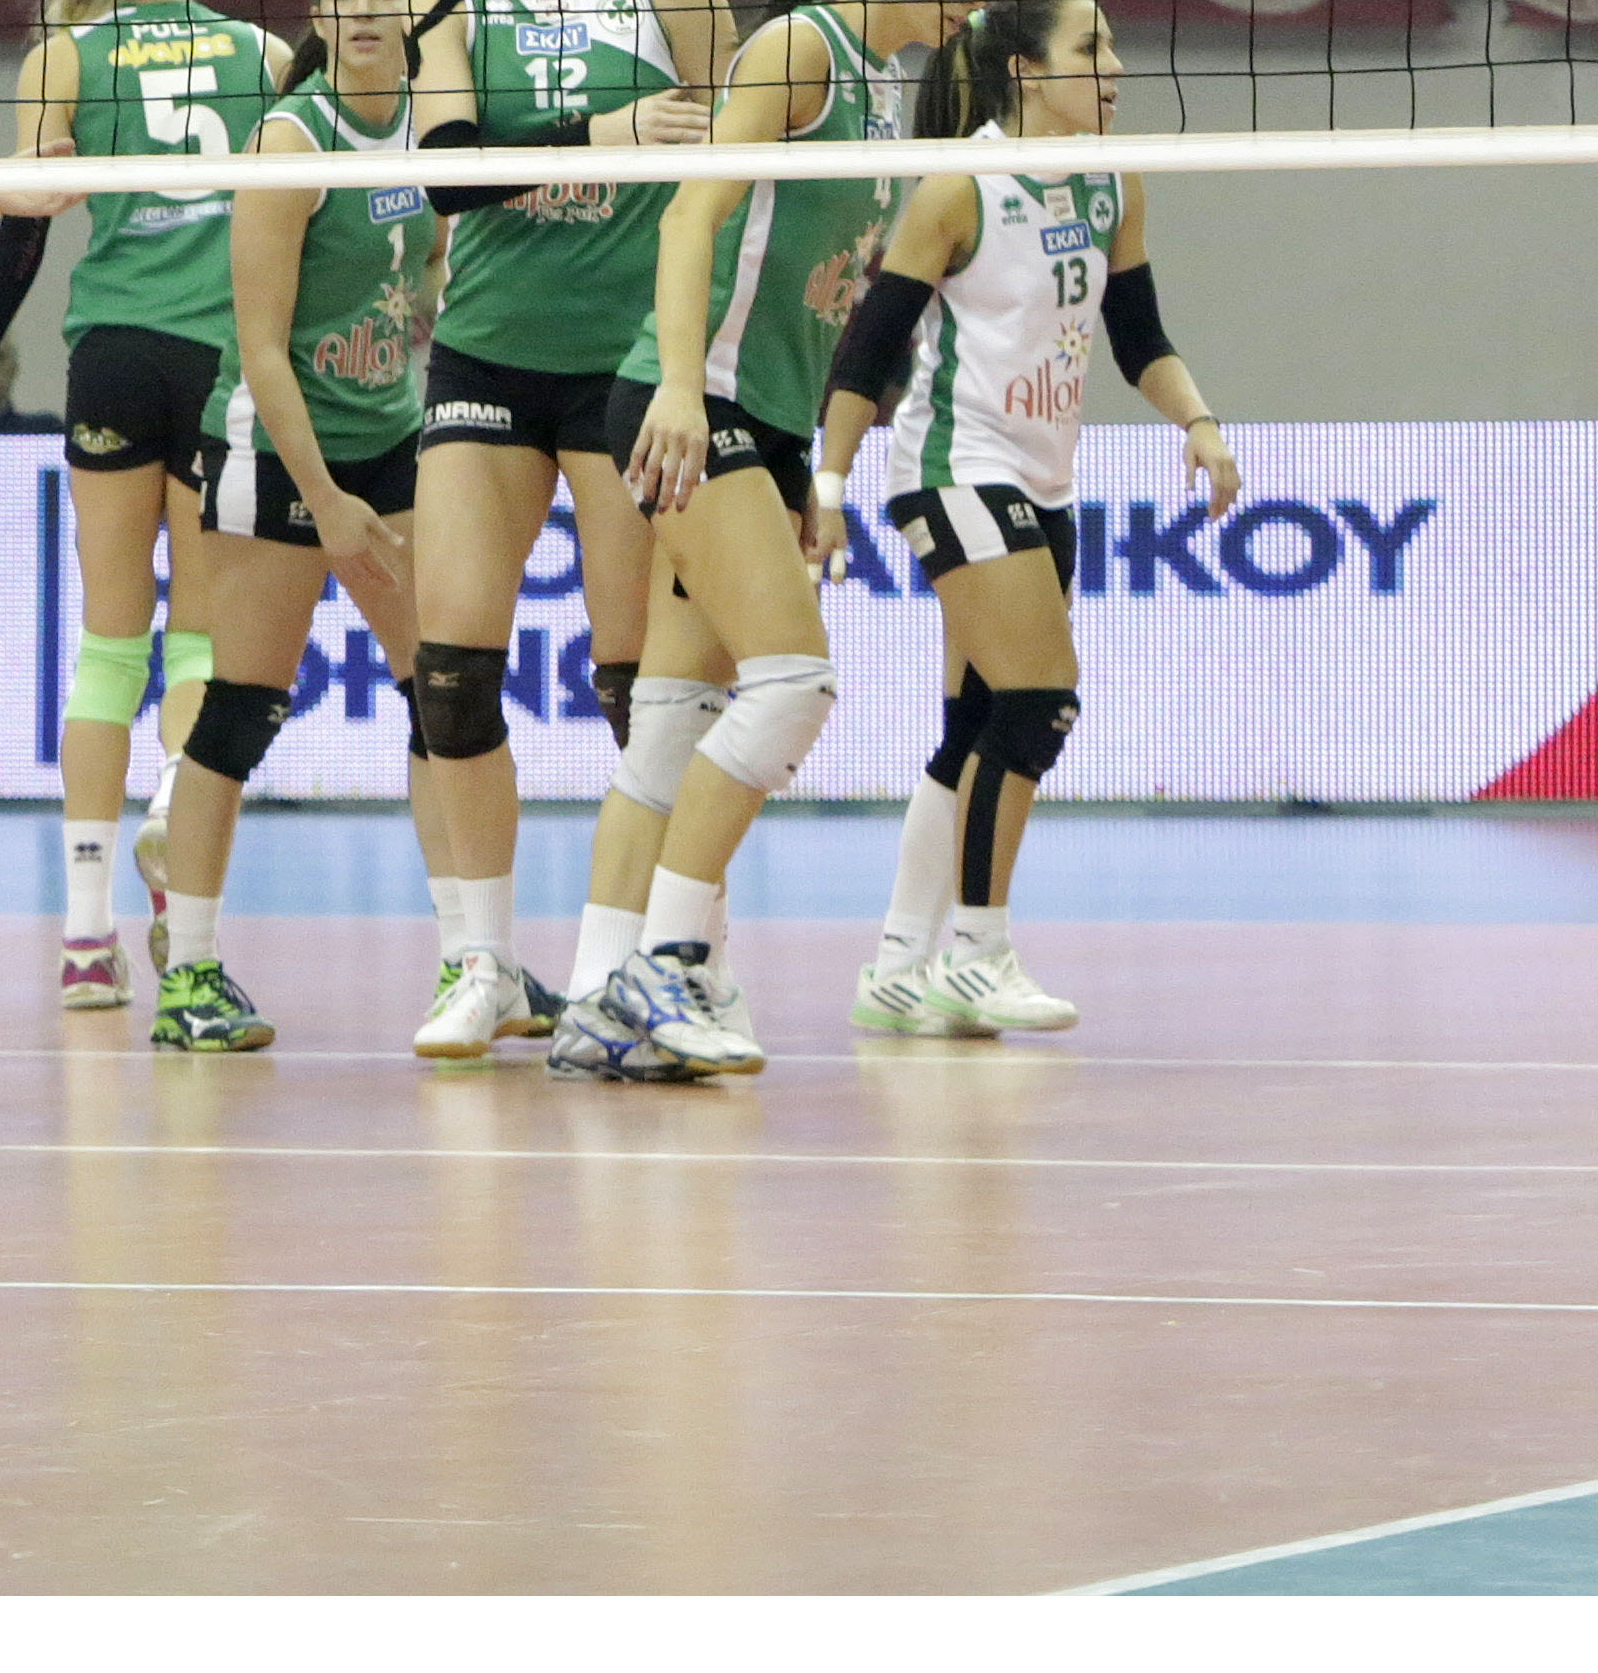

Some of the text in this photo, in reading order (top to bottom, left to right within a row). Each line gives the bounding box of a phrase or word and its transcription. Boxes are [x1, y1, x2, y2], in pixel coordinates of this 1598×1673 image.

[524, 57, 589, 109] 12
[138, 65, 231, 202] 5
[387, 223, 405, 271] 1
[1051, 256, 1088, 308] 13
